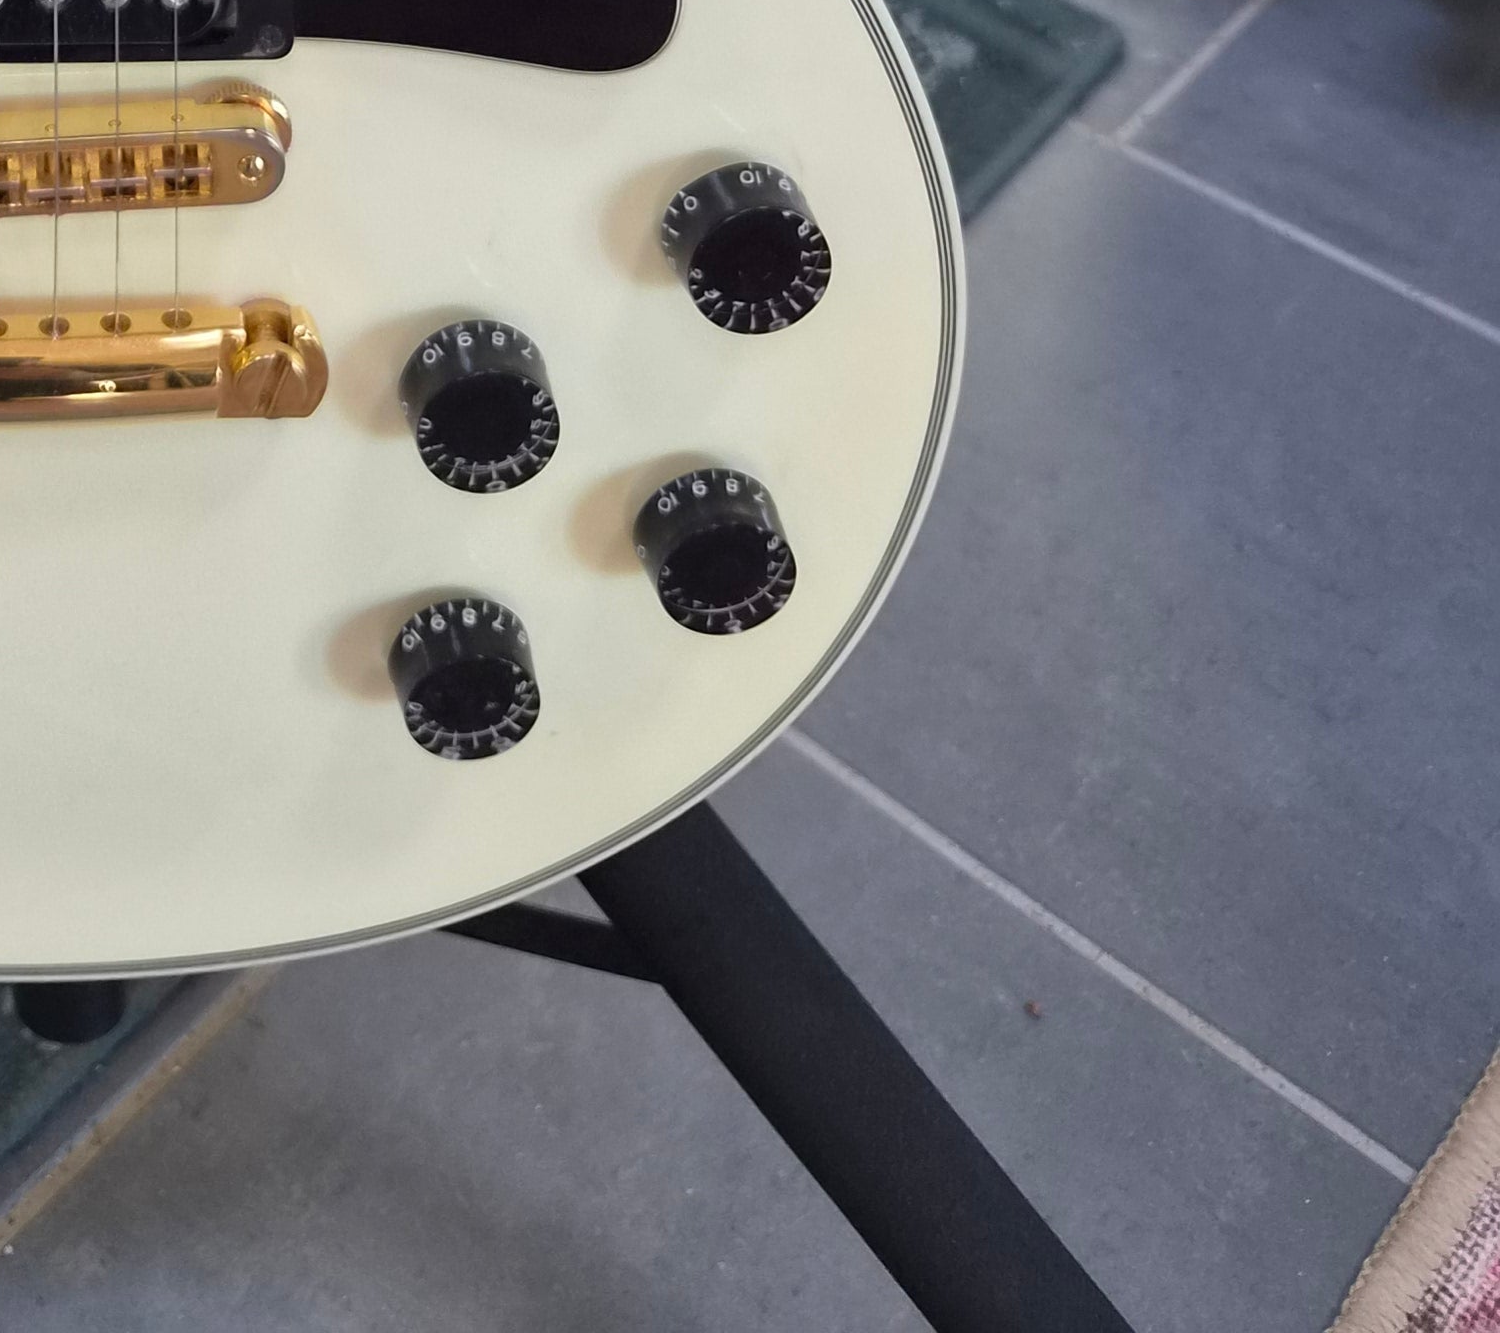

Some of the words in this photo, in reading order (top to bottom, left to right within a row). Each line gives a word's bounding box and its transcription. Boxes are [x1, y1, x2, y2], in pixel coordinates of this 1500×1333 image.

[739, 170, 761, 184] 10
[683, 195, 698, 210] 0
[492, 331, 505, 345] 8
[423, 343, 444, 363] 10
[725, 478, 738, 494] 8
[658, 491, 679, 513] 10
[462, 607, 477, 625] 8
